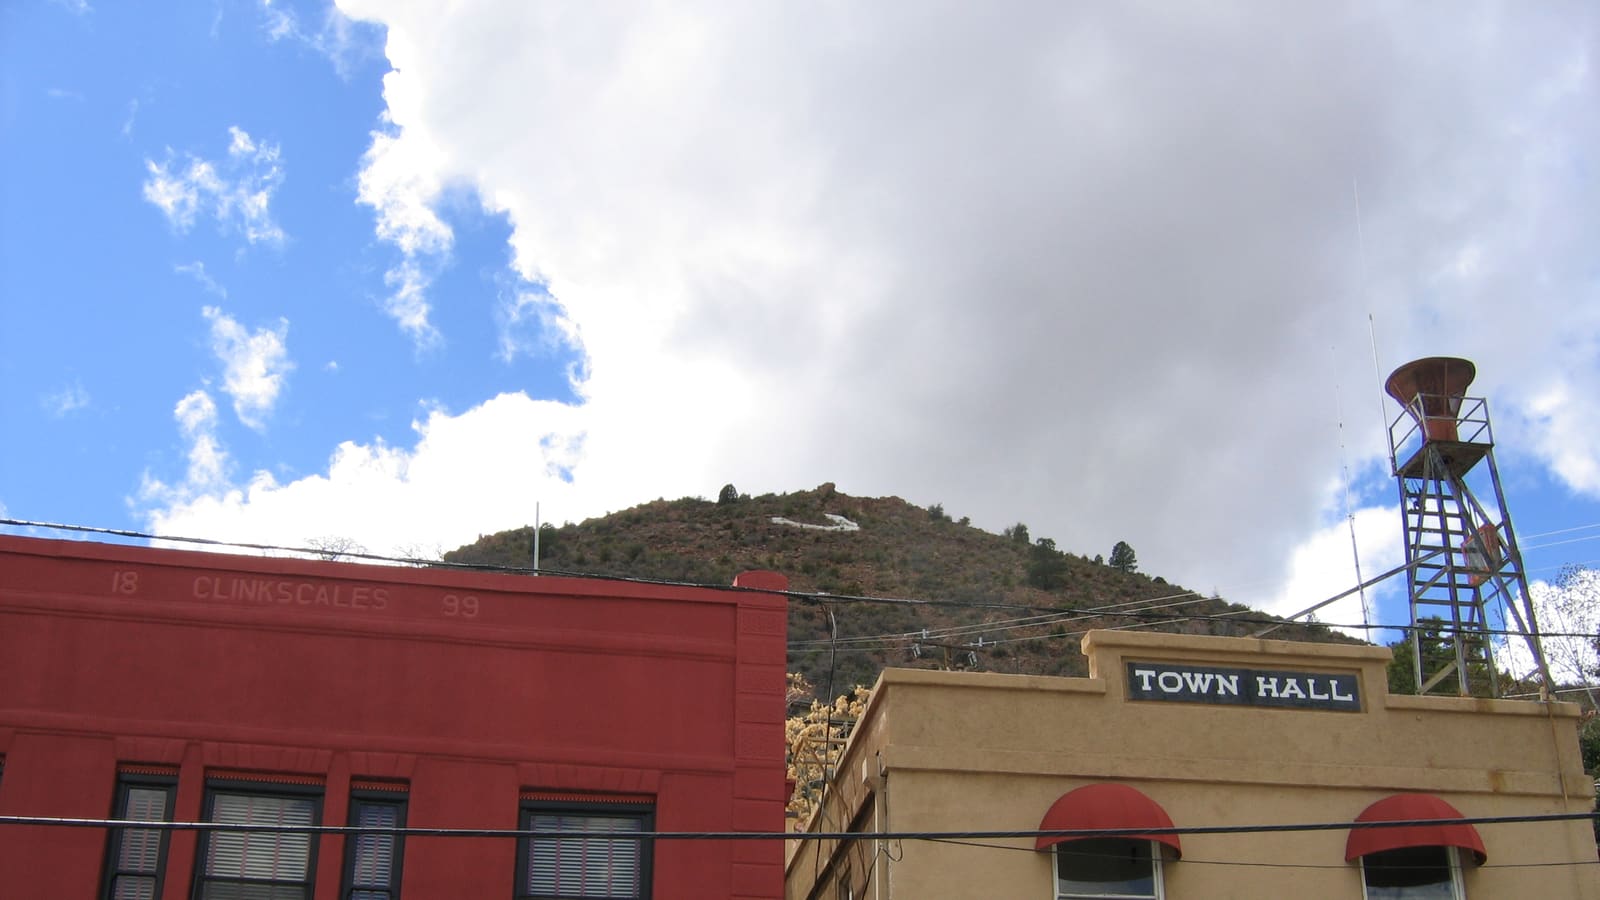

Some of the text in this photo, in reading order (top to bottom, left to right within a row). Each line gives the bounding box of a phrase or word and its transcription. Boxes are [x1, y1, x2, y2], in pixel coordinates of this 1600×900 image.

[111, 571, 480, 618] 18 CLINKSCALES 99
[1135, 669, 1353, 702] TOWN HALL
